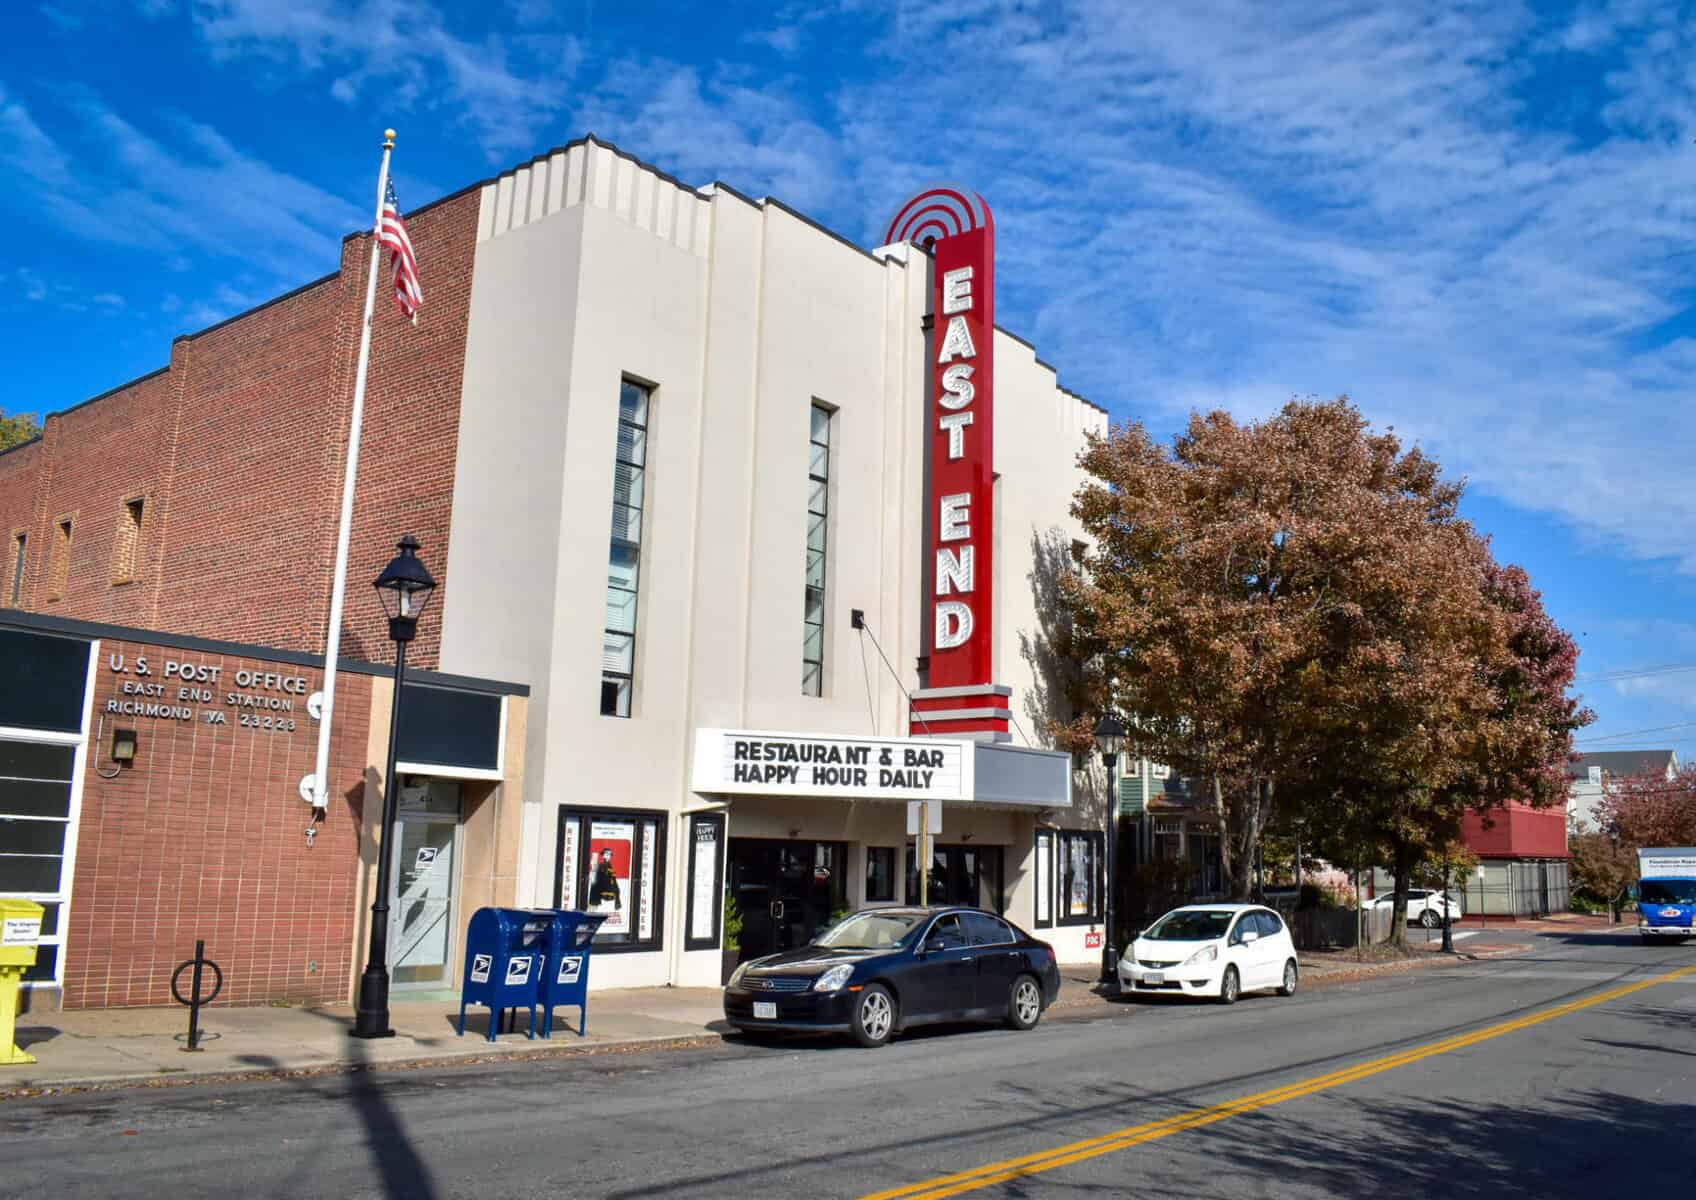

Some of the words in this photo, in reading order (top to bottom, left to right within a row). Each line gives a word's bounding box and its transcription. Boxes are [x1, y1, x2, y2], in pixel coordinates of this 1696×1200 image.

[938, 266, 977, 459] EAST
[936, 492, 975, 649] END
[109, 654, 128, 673] U.
[135, 656, 151, 676] S.
[164, 660, 221, 683] POST
[235, 670, 307, 694] OFFICE
[123, 681, 164, 697] EAST
[179, 688, 213, 704] END
[227, 692, 292, 712] STATION
[107, 700, 192, 720] RICHMOND
[207, 711, 226, 725] VA
[240, 714, 296, 732] 23223
[734, 741, 871, 765] RESTAURANT
[879, 747, 893, 766] &
[903, 749, 945, 768] BAR
[734, 763, 800, 785] HAPPY
[812, 766, 868, 787] HOUR
[879, 769, 934, 789] DAILY
